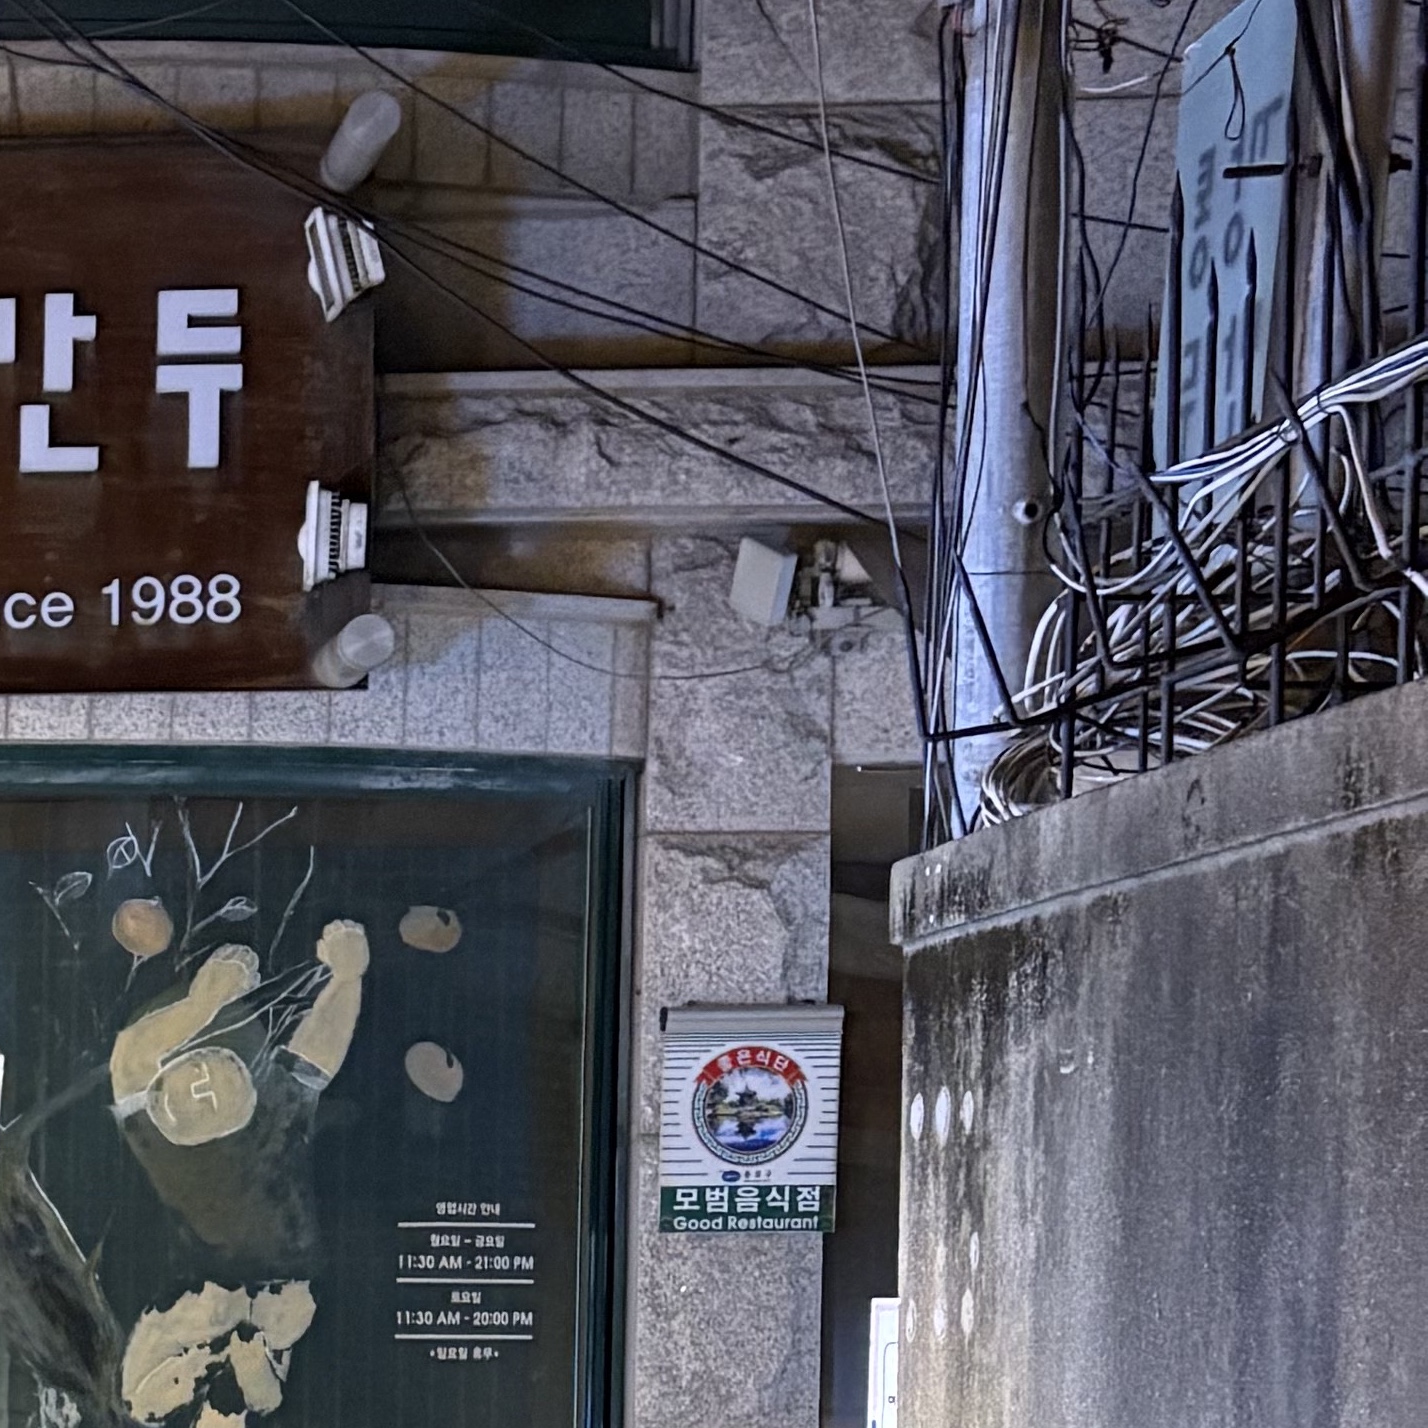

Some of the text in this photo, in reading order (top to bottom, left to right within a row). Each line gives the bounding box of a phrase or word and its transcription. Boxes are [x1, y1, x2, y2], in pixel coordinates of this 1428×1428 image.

[101, 574, 242, 626] 1988
[673, 1186, 821, 1213] 모범음식점
[673, 1215, 819, 1231] Good Restaurant
[475, 1234, 505, 1248] 금요일
[398, 1255, 435, 1270] 11:30
[438, 1255, 462, 1270] AM
[474, 1255, 510, 1270] 21:00
[513, 1256, 534, 1270] PM
[396, 1311, 433, 1325] 11:30
[436, 1311, 461, 1325] AM
[472, 1311, 509, 1326] 20:00
[512, 1311, 533, 1326] PM
